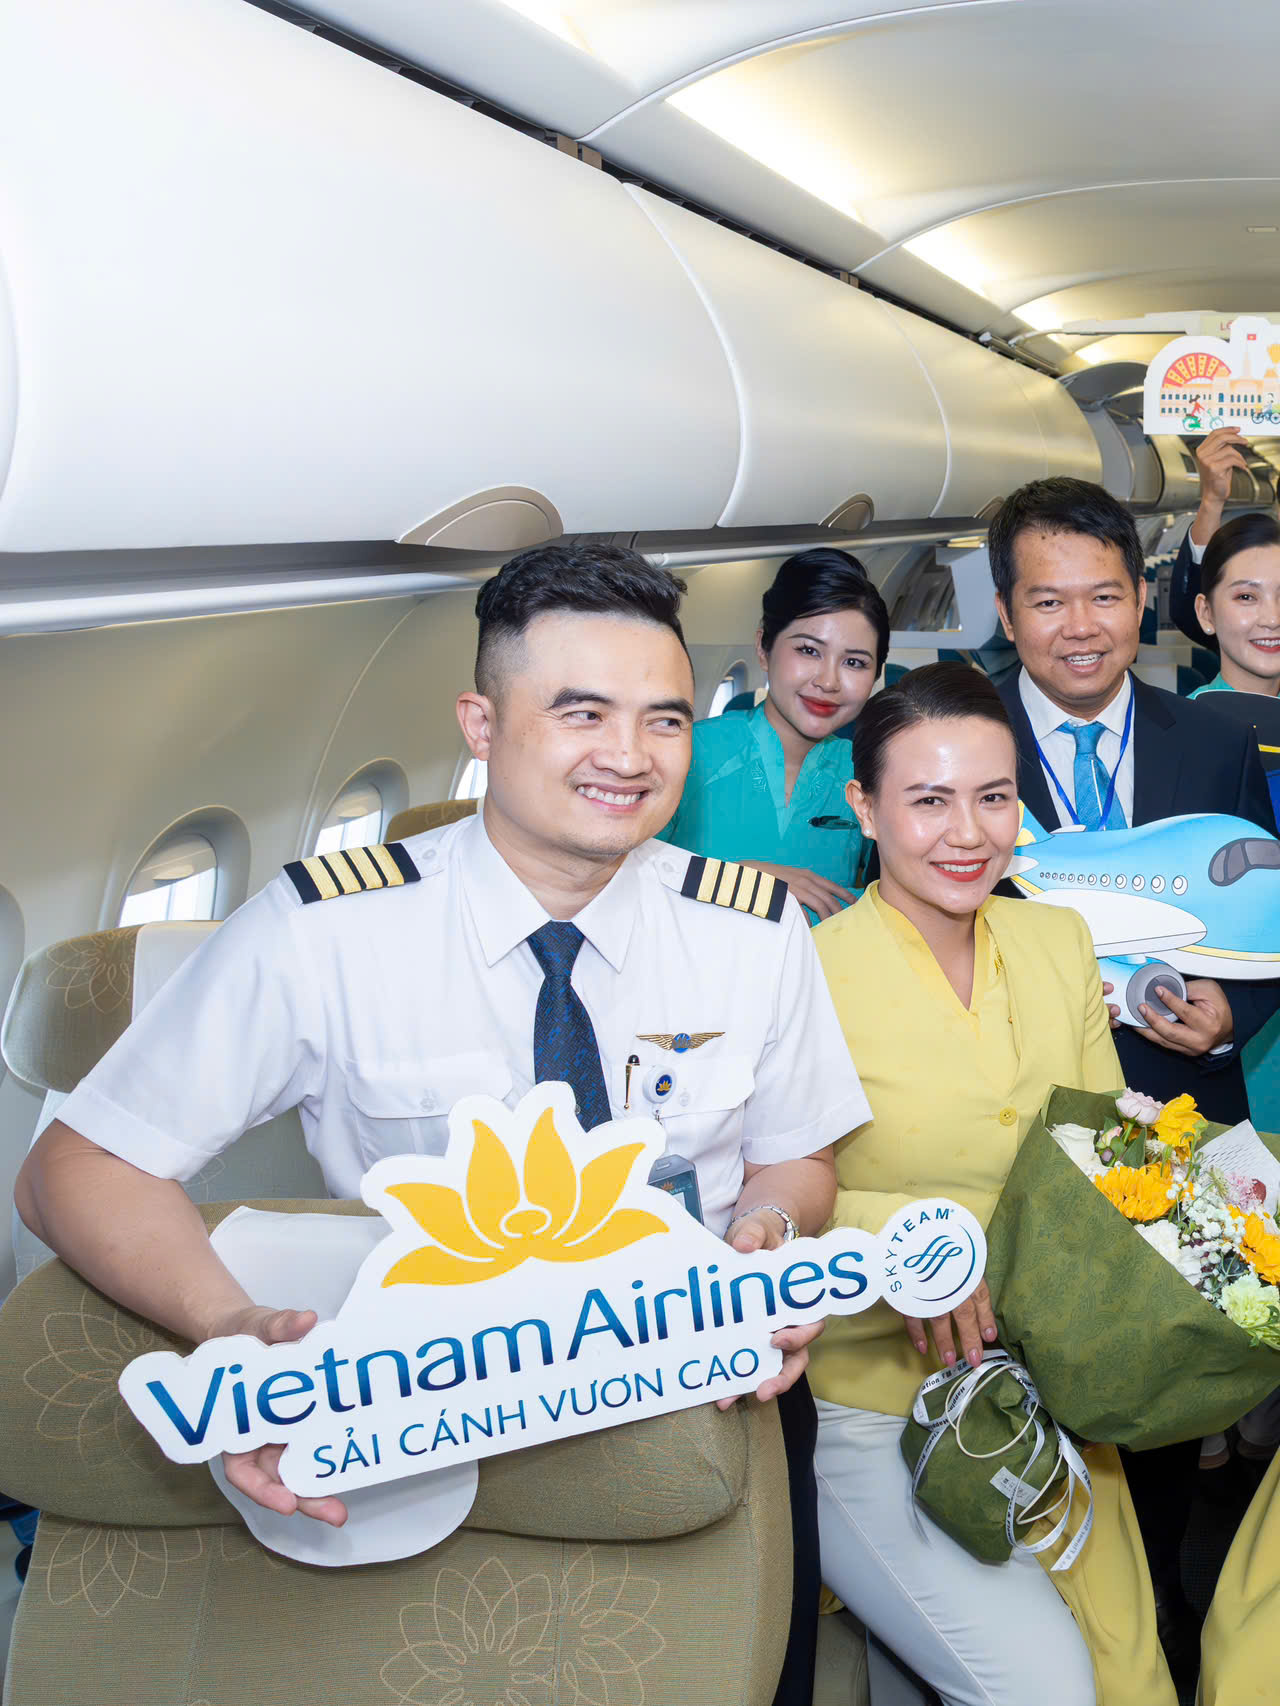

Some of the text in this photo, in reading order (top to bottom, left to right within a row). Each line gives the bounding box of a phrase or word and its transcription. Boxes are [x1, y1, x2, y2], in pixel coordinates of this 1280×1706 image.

[885, 1208, 950, 1293] SKYTEAM
[145, 1251, 869, 1446] Vietnam Airlines
[313, 1347, 760, 1479] SẢI CÁNH VƯƠN CAO
